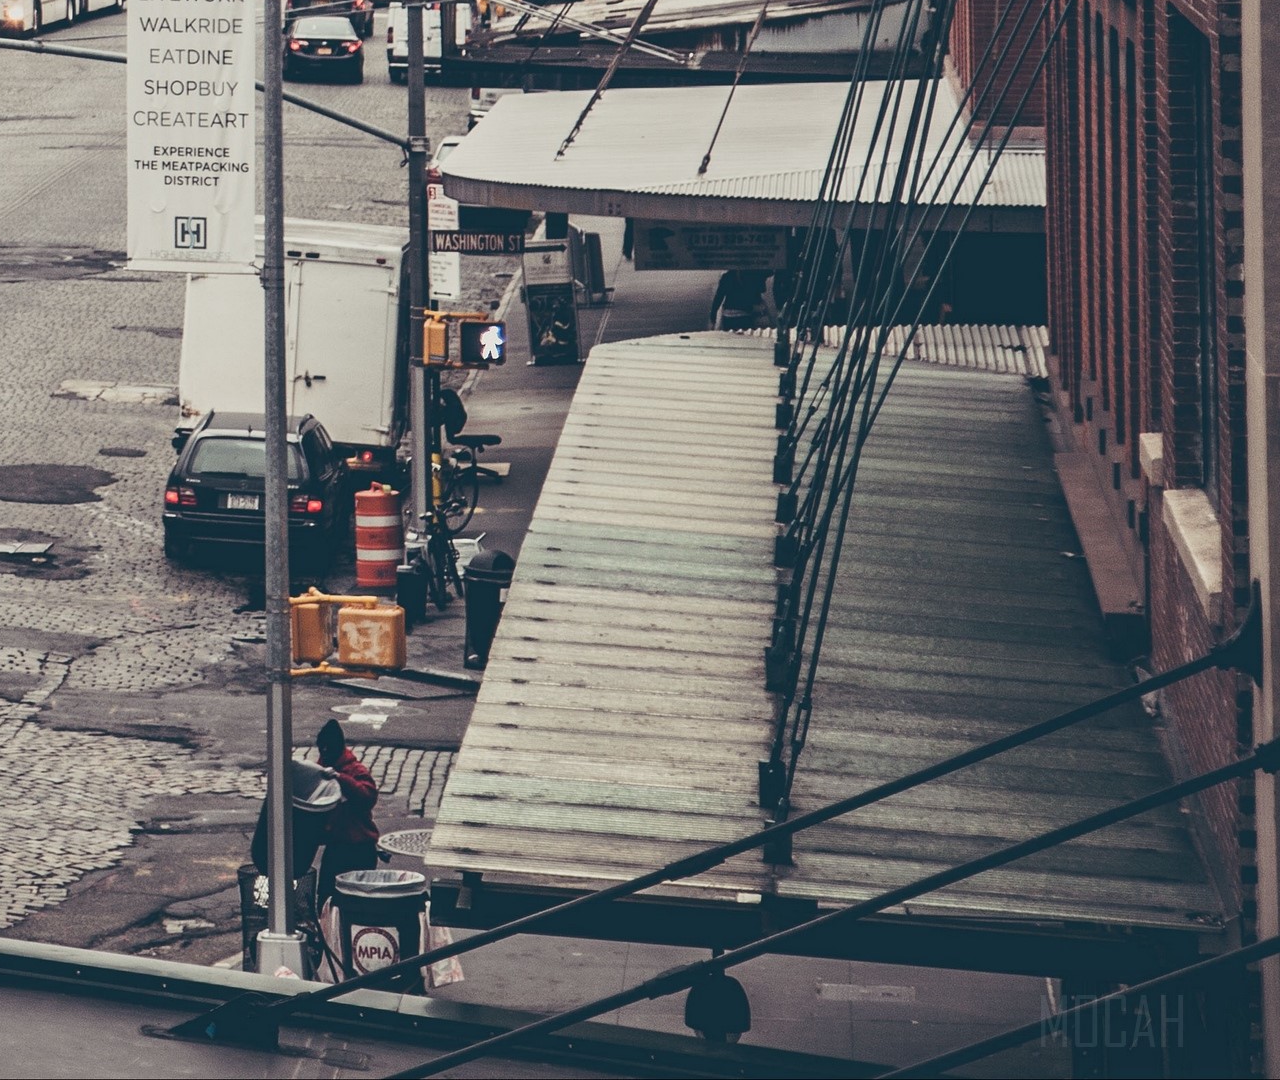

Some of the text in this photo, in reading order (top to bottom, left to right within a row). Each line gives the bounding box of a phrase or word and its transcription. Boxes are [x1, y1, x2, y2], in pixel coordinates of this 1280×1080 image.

[139, 17, 243, 34] WALKRIDE
[149, 48, 233, 65] EATDINE
[144, 79, 238, 96] SHOPBUY
[133, 110, 249, 128] CREATEART
[153, 146, 230, 157] EXPERIENCE
[134, 160, 249, 173] THE MEATPACKING
[164, 175, 220, 186] DISTRICT
[435, 233, 521, 251] WASHINGTON ST
[357, 946, 392, 960] MPIA
